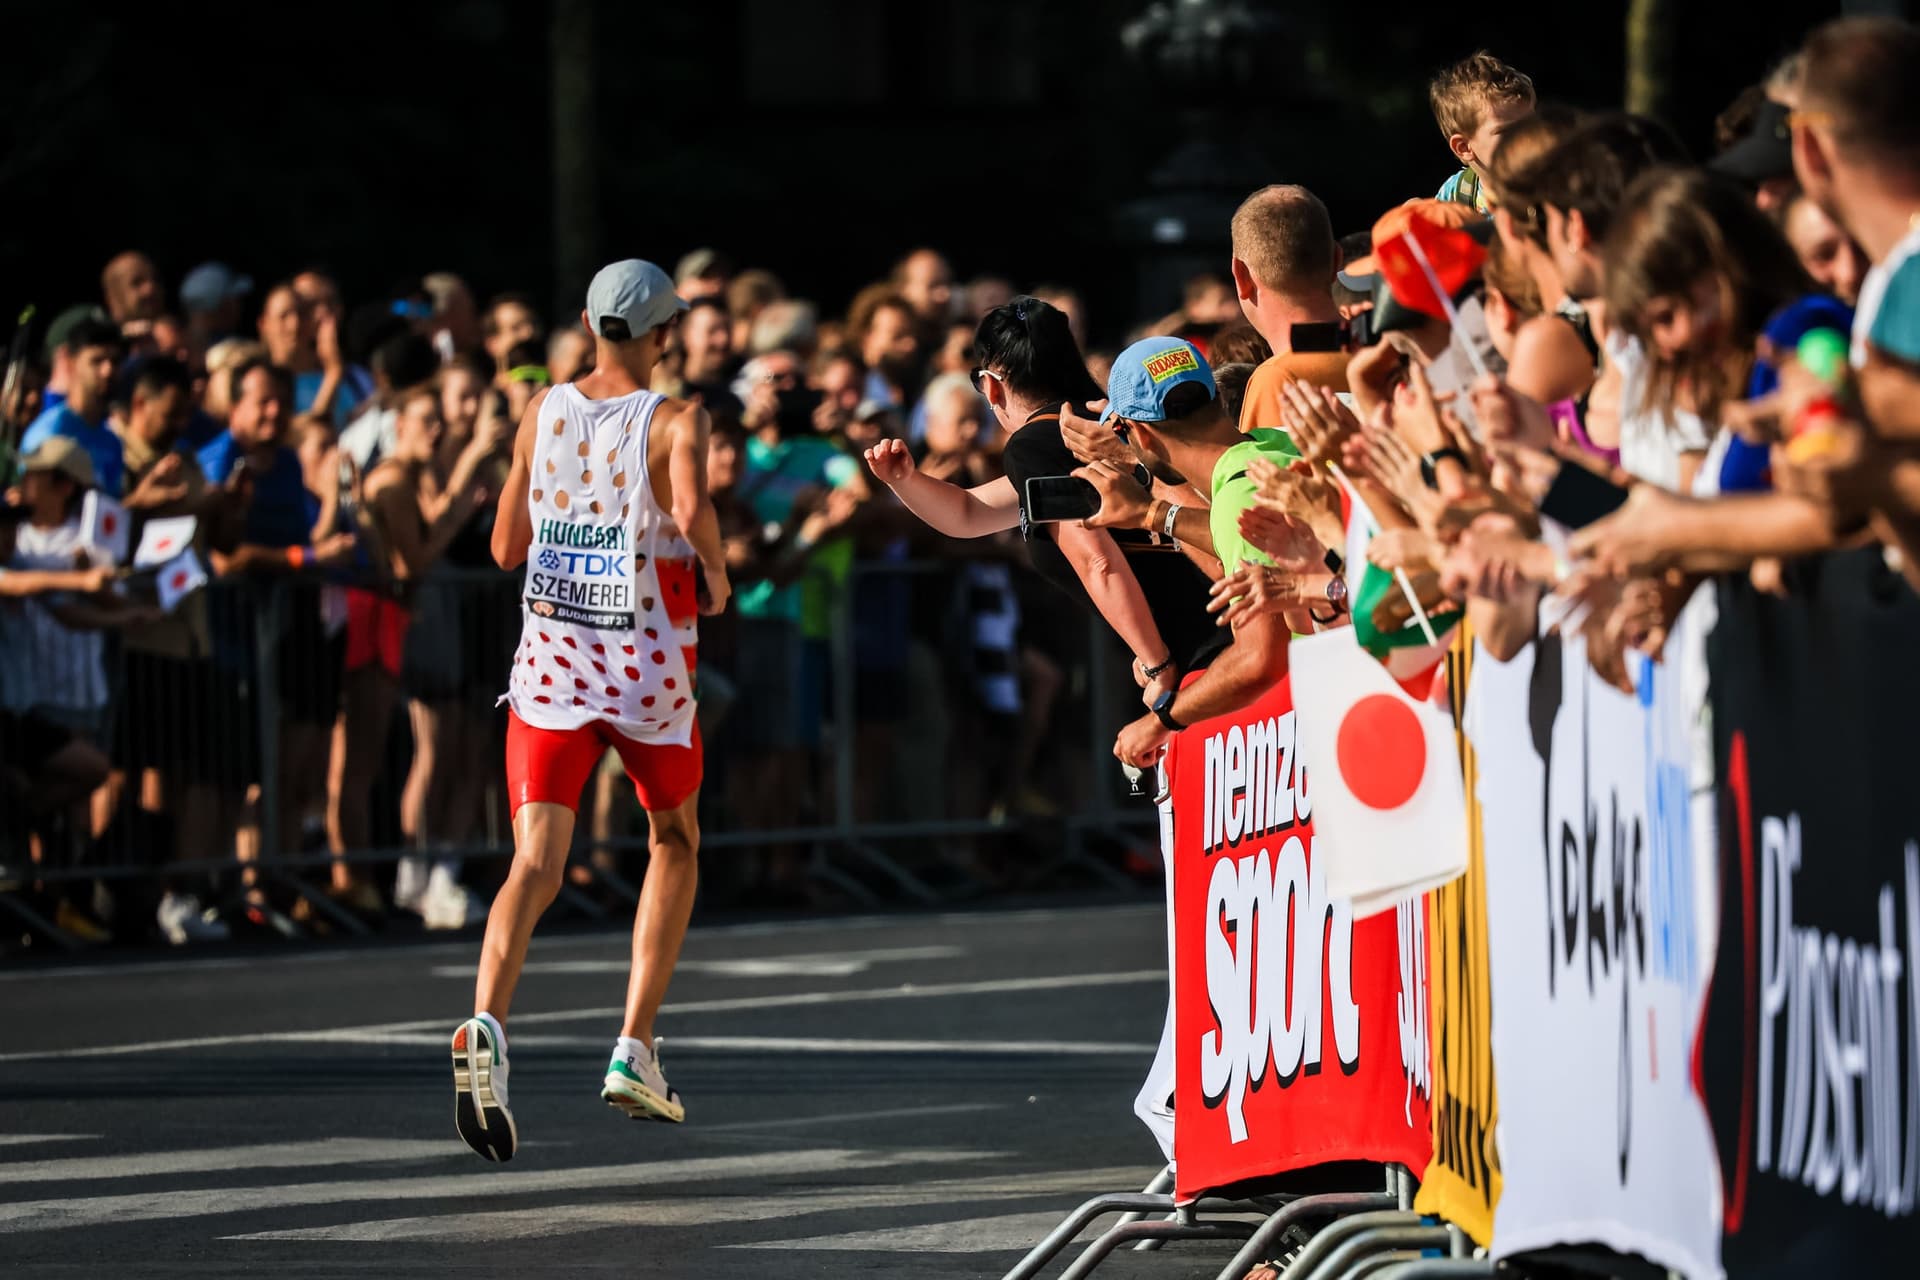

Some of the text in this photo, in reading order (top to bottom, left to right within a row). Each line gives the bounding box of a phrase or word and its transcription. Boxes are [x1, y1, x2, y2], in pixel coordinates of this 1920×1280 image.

[1147, 350, 1193, 376] BUDAPEST
[539, 518, 627, 550] HUNGARY
[561, 552, 626, 576] TDK
[531, 573, 628, 608] SZEMEREI
[1201, 834, 1360, 1145] sport
